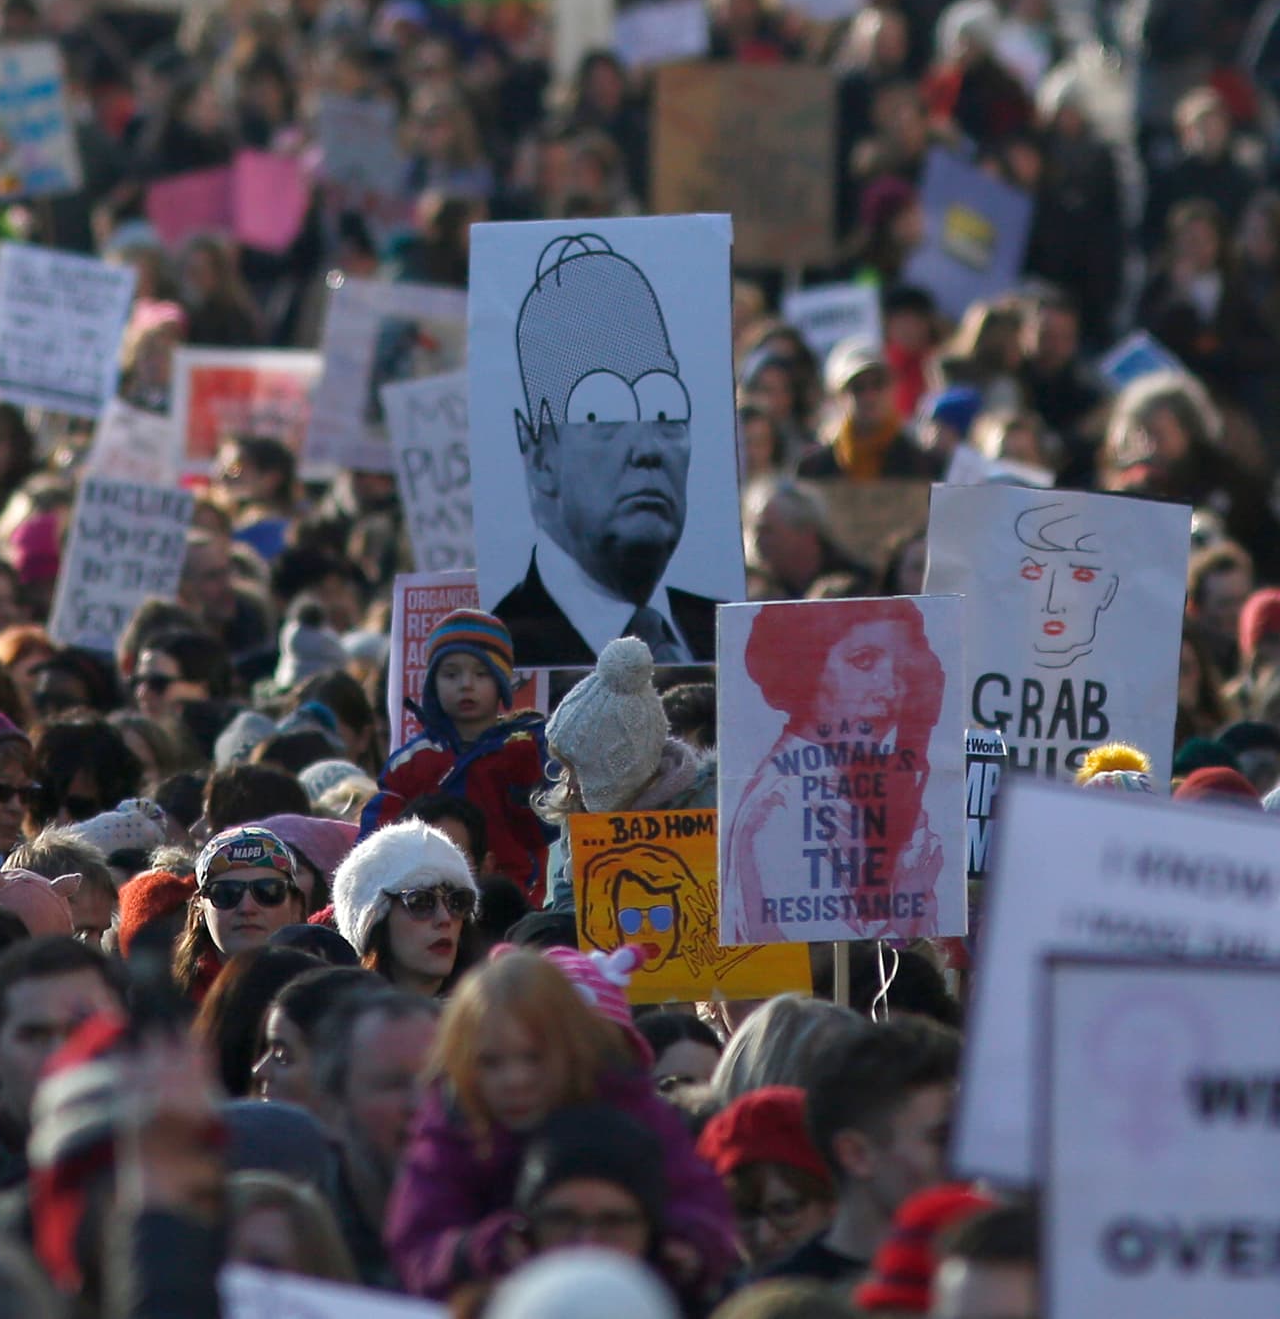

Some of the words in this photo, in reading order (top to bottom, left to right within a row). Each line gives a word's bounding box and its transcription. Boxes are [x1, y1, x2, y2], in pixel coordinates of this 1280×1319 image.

[972, 673, 1110, 741] GRAB
[773, 740, 916, 777] WOMAN'S
[802, 772, 887, 801] PLACE
[803, 805, 836, 842] IS
[851, 805, 887, 840] IN
[232, 846, 262, 859] MAPEI
[802, 846, 888, 890] THE
[761, 892, 927, 924] RESISTANCE
